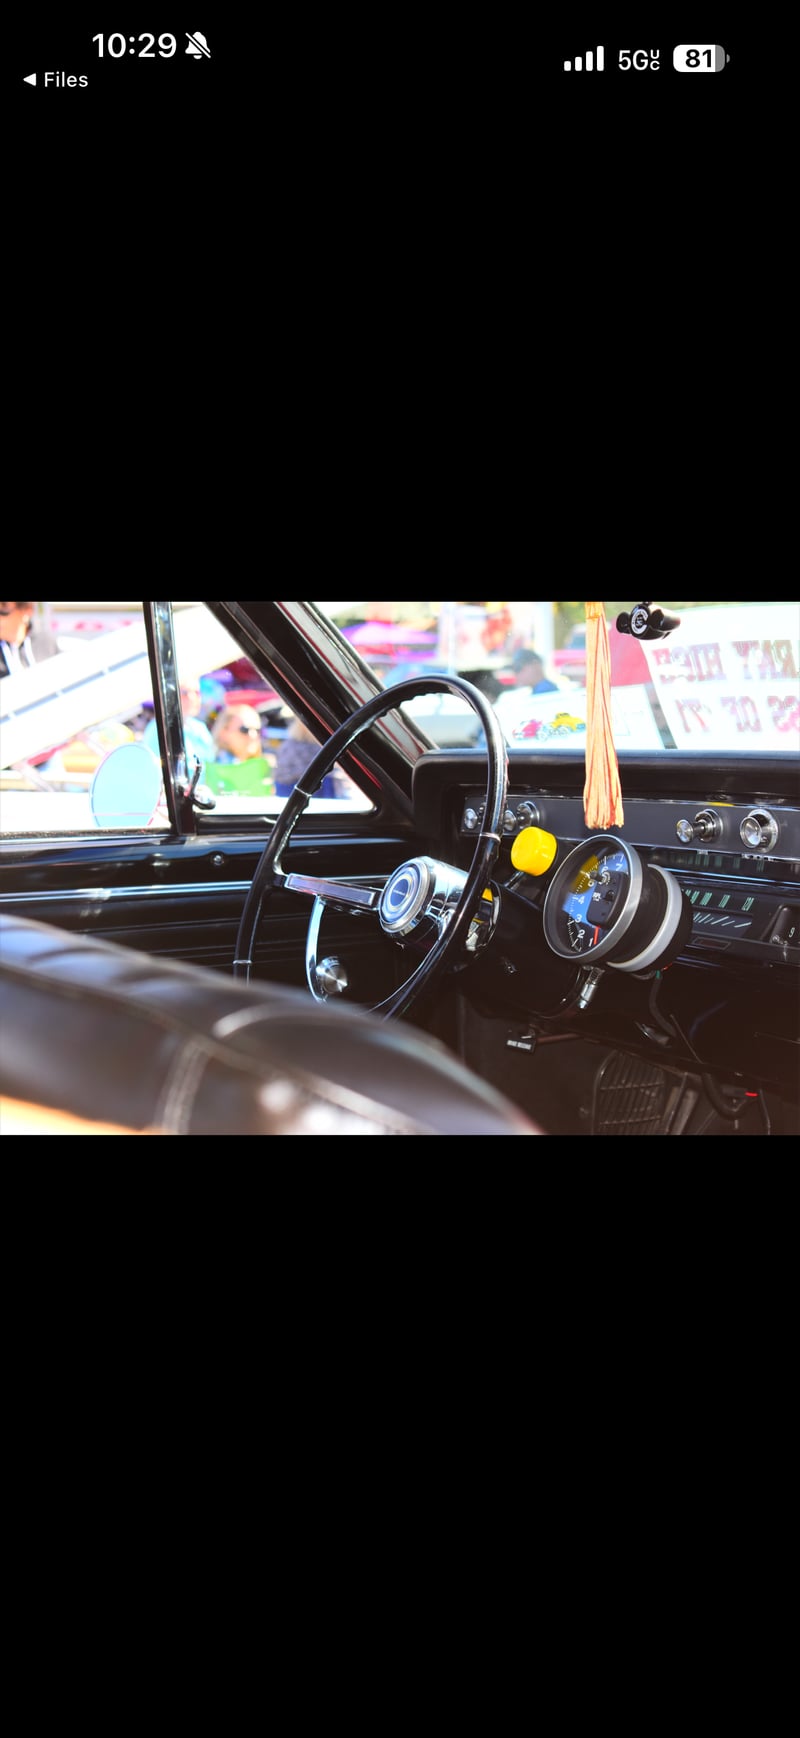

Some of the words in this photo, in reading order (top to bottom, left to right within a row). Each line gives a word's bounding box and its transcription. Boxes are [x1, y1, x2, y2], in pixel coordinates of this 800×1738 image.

[575, 914, 582, 923] 3
[577, 930, 585, 939] 2
[588, 938, 593, 947] 1
